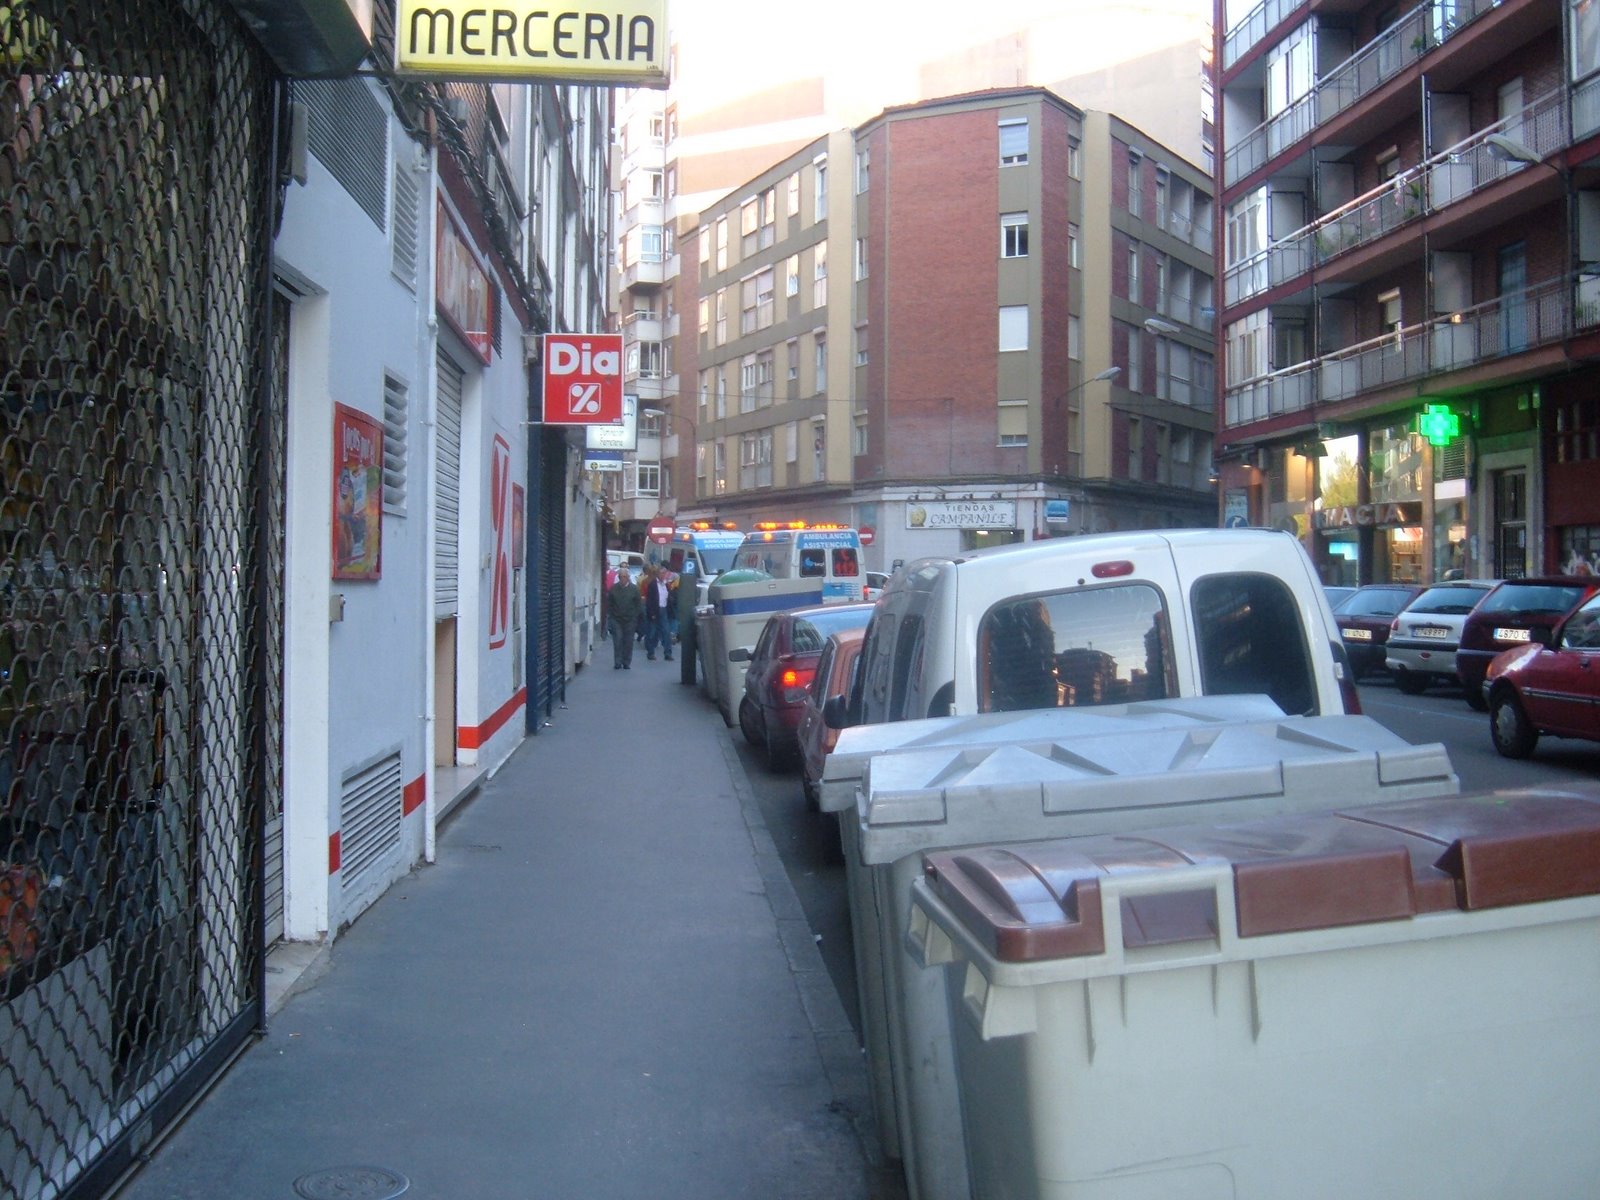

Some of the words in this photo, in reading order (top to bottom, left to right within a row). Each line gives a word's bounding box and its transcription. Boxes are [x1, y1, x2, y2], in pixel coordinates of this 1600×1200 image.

[410, 8, 655, 61] MERCERIA
[550, 343, 619, 375] Dia
[930, 513, 1007, 524] CAMPANILE
[946, 504, 995, 512] TIENDAS
